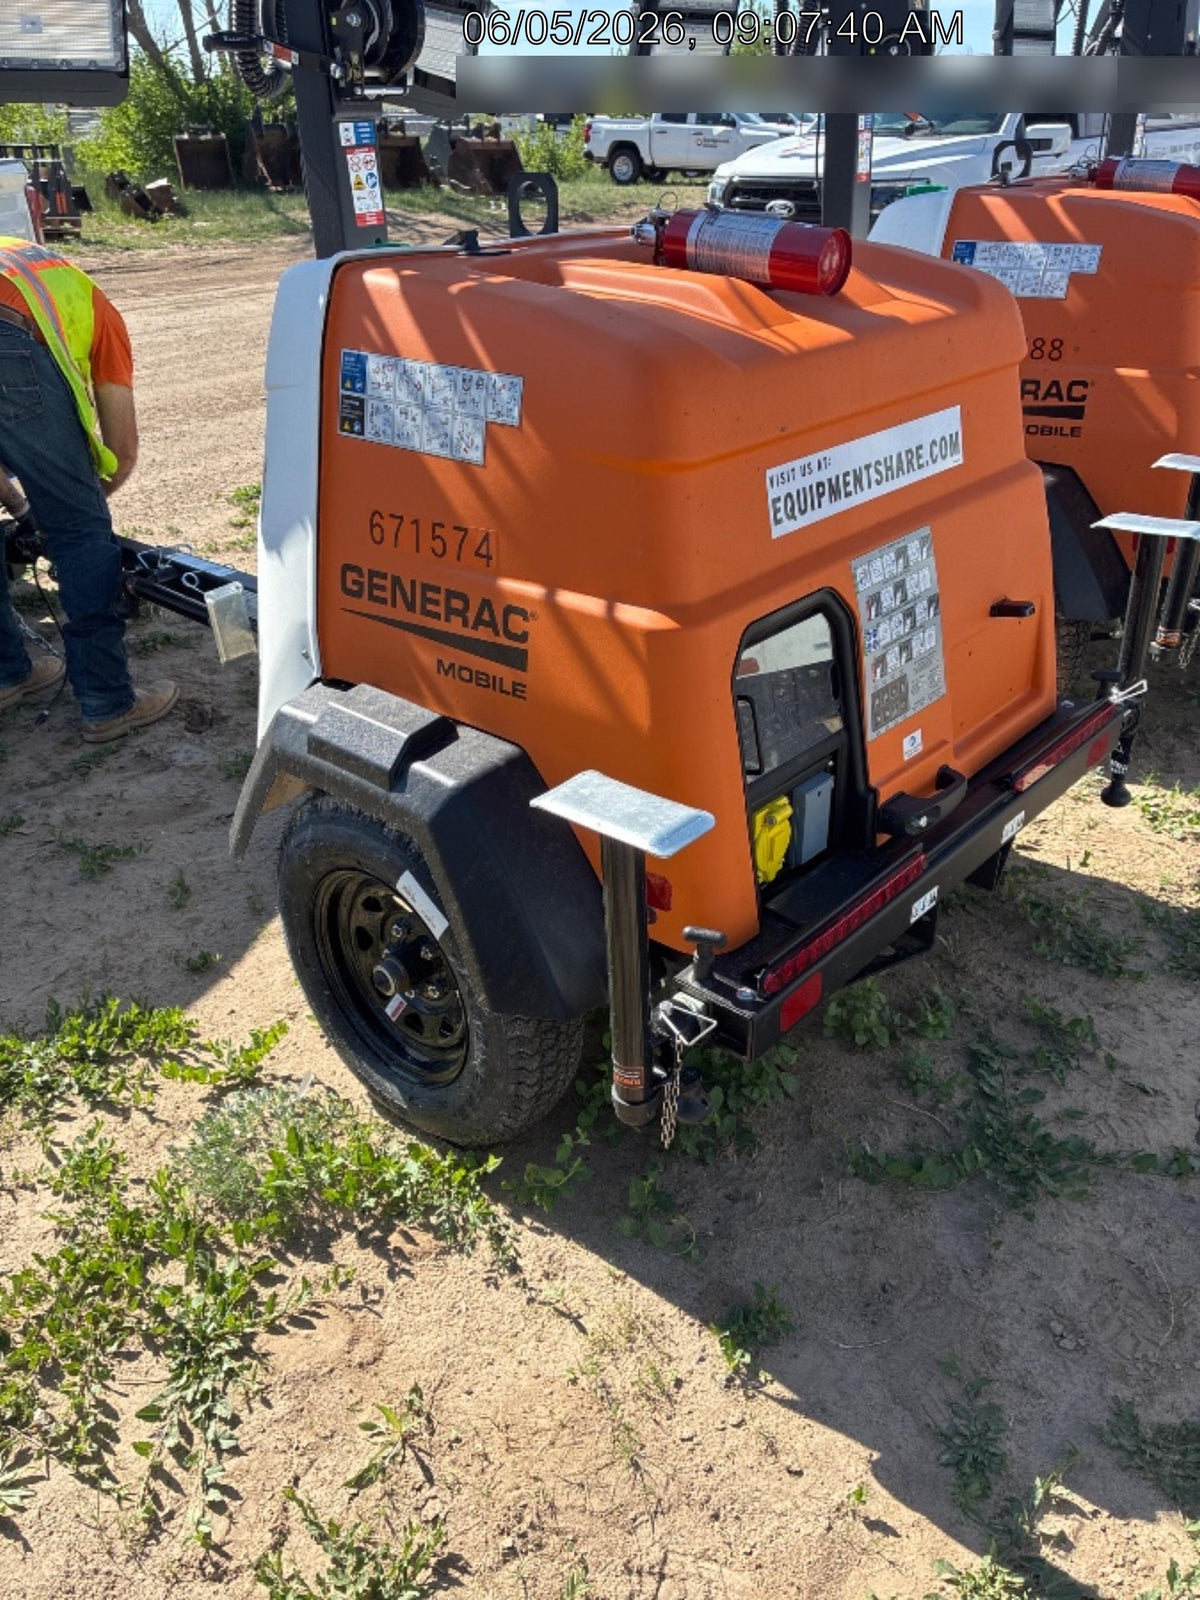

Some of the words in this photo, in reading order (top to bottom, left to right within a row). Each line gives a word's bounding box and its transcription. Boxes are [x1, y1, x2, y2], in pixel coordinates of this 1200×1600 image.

[1025, 337, 1064, 361] 88
[769, 467, 796, 489] VISIT
[799, 462, 813, 477] US
[817, 456, 832, 472] AT:
[771, 431, 960, 527] EQUIPMENTSHARE.COM
[368, 510, 494, 567] 671574
[436, 658, 528, 701] MOBILE
